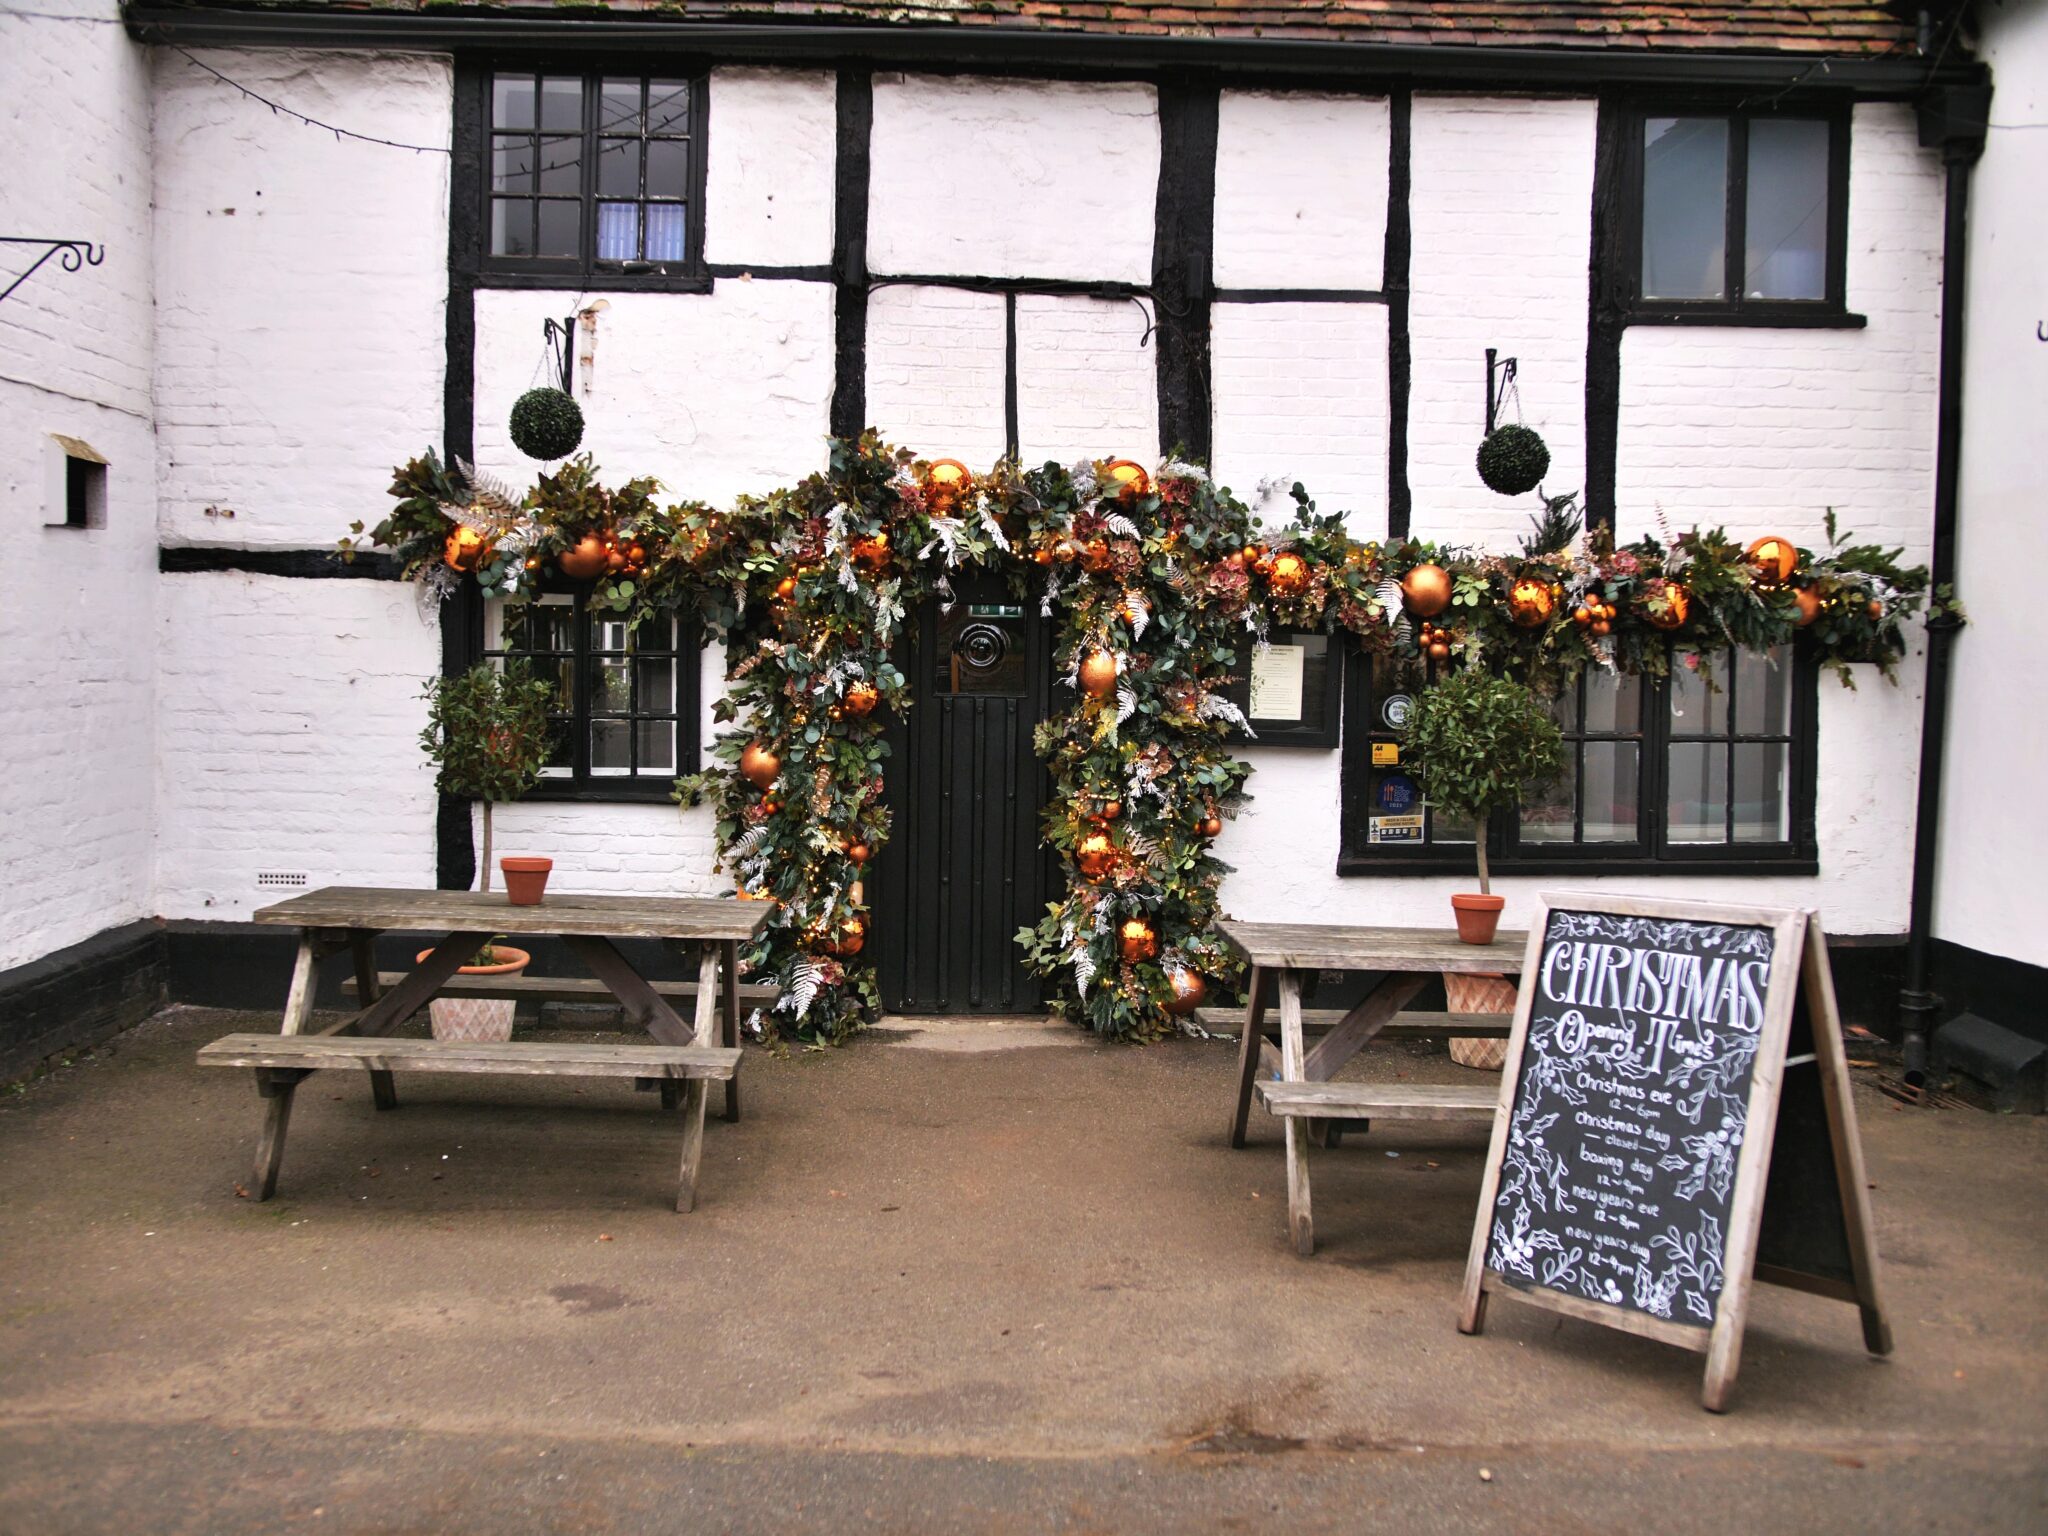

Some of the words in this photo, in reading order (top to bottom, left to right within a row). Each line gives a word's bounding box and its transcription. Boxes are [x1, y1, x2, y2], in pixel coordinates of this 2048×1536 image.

[1541, 941, 1769, 1034] CHRISTMAS
[1556, 1010, 1635, 1060] Opening
[1644, 1017, 1715, 1075] Times
[1576, 1072, 1645, 1100] Christmas
[1650, 1090, 1673, 1105] eve
[1645, 1124, 1671, 1151] day
[1580, 1142, 1624, 1175] boxing
[1630, 1158, 1653, 1182] day
[1572, 1185, 1598, 1202] new
[1597, 1192, 1634, 1210] years
[1638, 1203, 1660, 1218] eve
[1565, 1226, 1592, 1240] new
[1593, 1234, 1629, 1251] years
[1629, 1241, 1651, 1264] day
